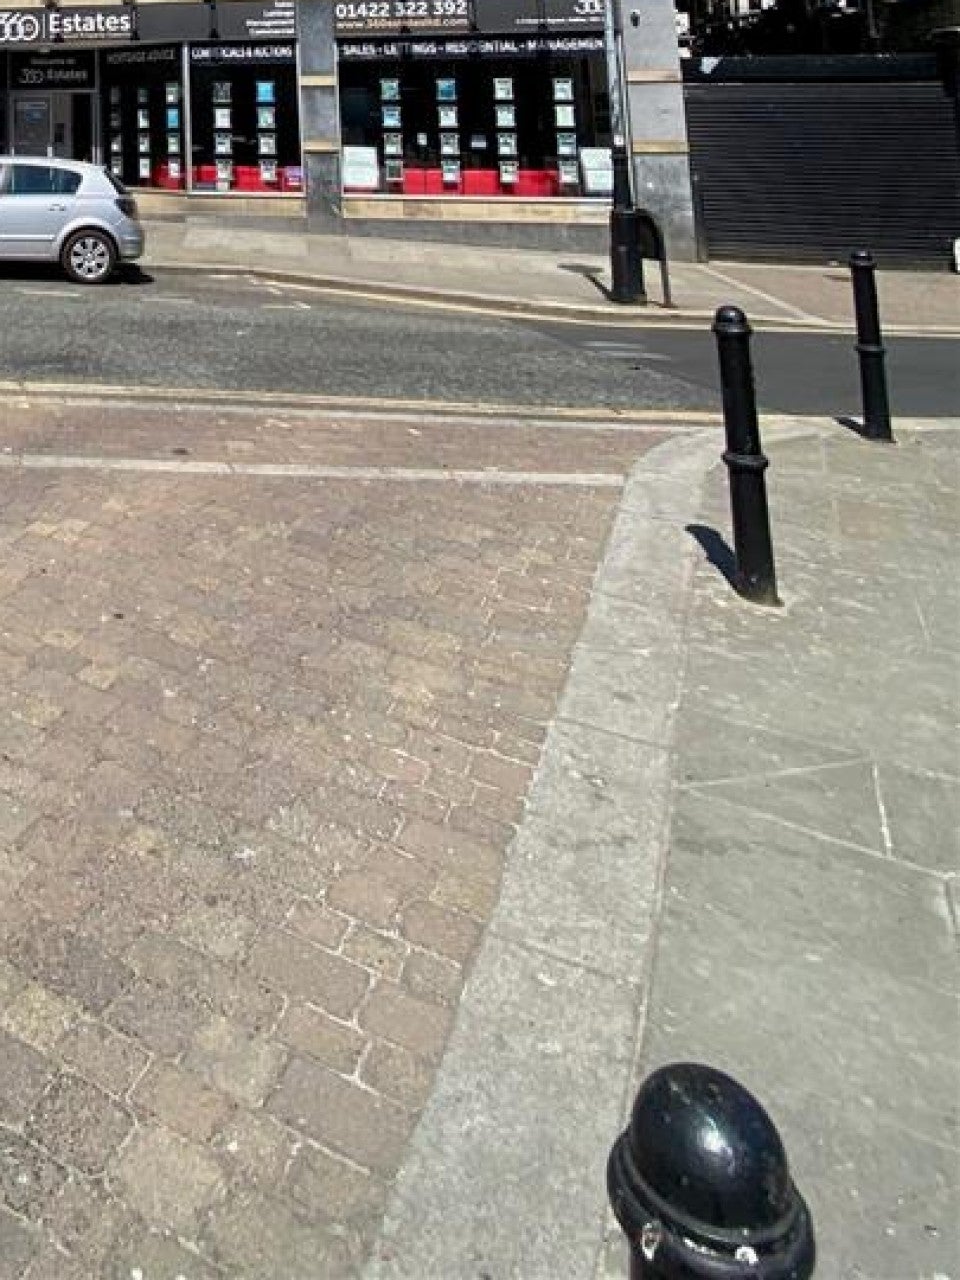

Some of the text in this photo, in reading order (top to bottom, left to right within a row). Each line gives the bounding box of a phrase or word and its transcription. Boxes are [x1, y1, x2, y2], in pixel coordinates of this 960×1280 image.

[336, 0, 390, 19] 01422
[394, 0, 428, 17] 322
[49, 13, 131, 32] Estates
